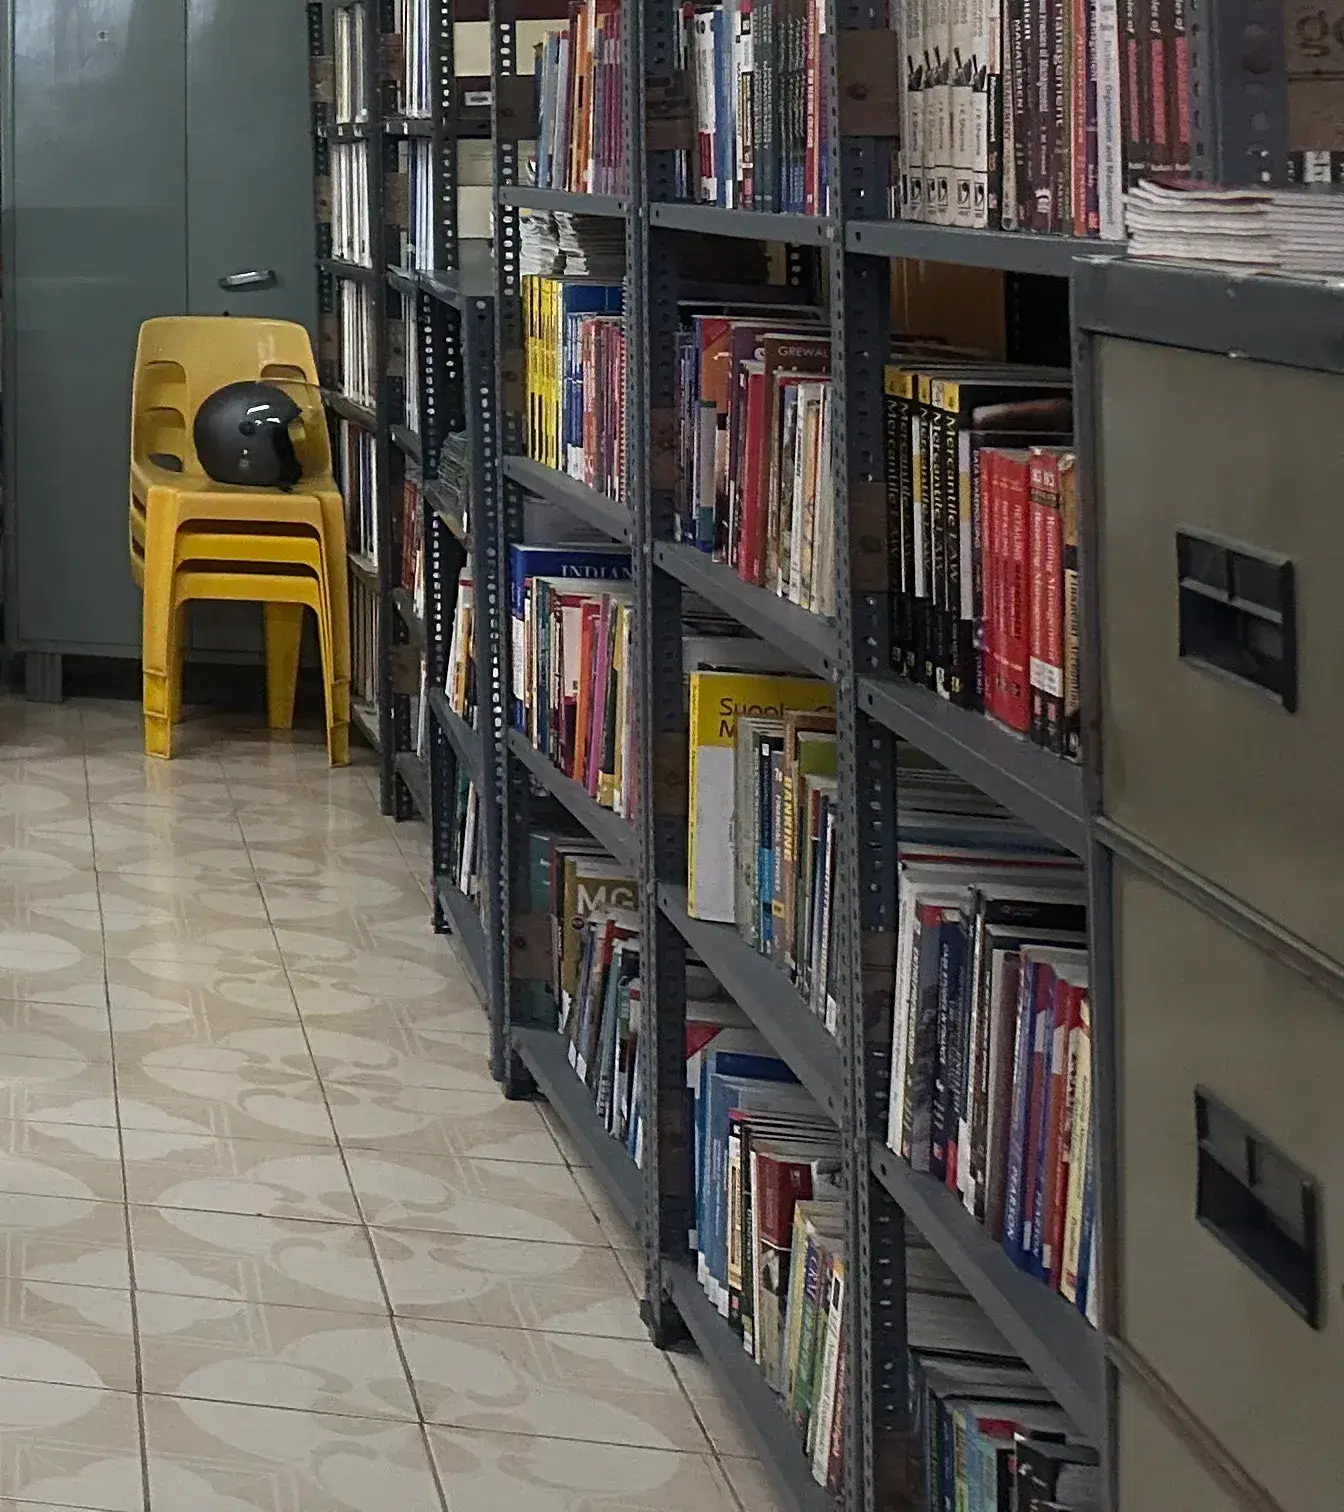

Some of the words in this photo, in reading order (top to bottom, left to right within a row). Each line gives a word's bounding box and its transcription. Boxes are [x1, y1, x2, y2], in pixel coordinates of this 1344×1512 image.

[1126, 21, 1135, 34] of
[1149, 21, 1161, 34] of
[1174, 18, 1185, 32] of
[1014, 19, 1024, 115] MANAGEMENT
[1053, 3, 1063, 127] Management
[777, 345, 830, 359] GREWAL
[887, 400, 900, 505] Mercantile
[920, 407, 931, 509] Mercantile
[932, 411, 943, 520] Mercantile
[944, 415, 958, 527] Mercantile
[561, 564, 633, 580] INDIAN
[1033, 511, 1041, 568] Retailing
[1045, 515, 1056, 573] Retailing
[1046, 577, 1056, 661] Management
[1006, 1165, 1020, 1241] PEARSON
[1032, 1189, 1043, 1258] PEARSON
